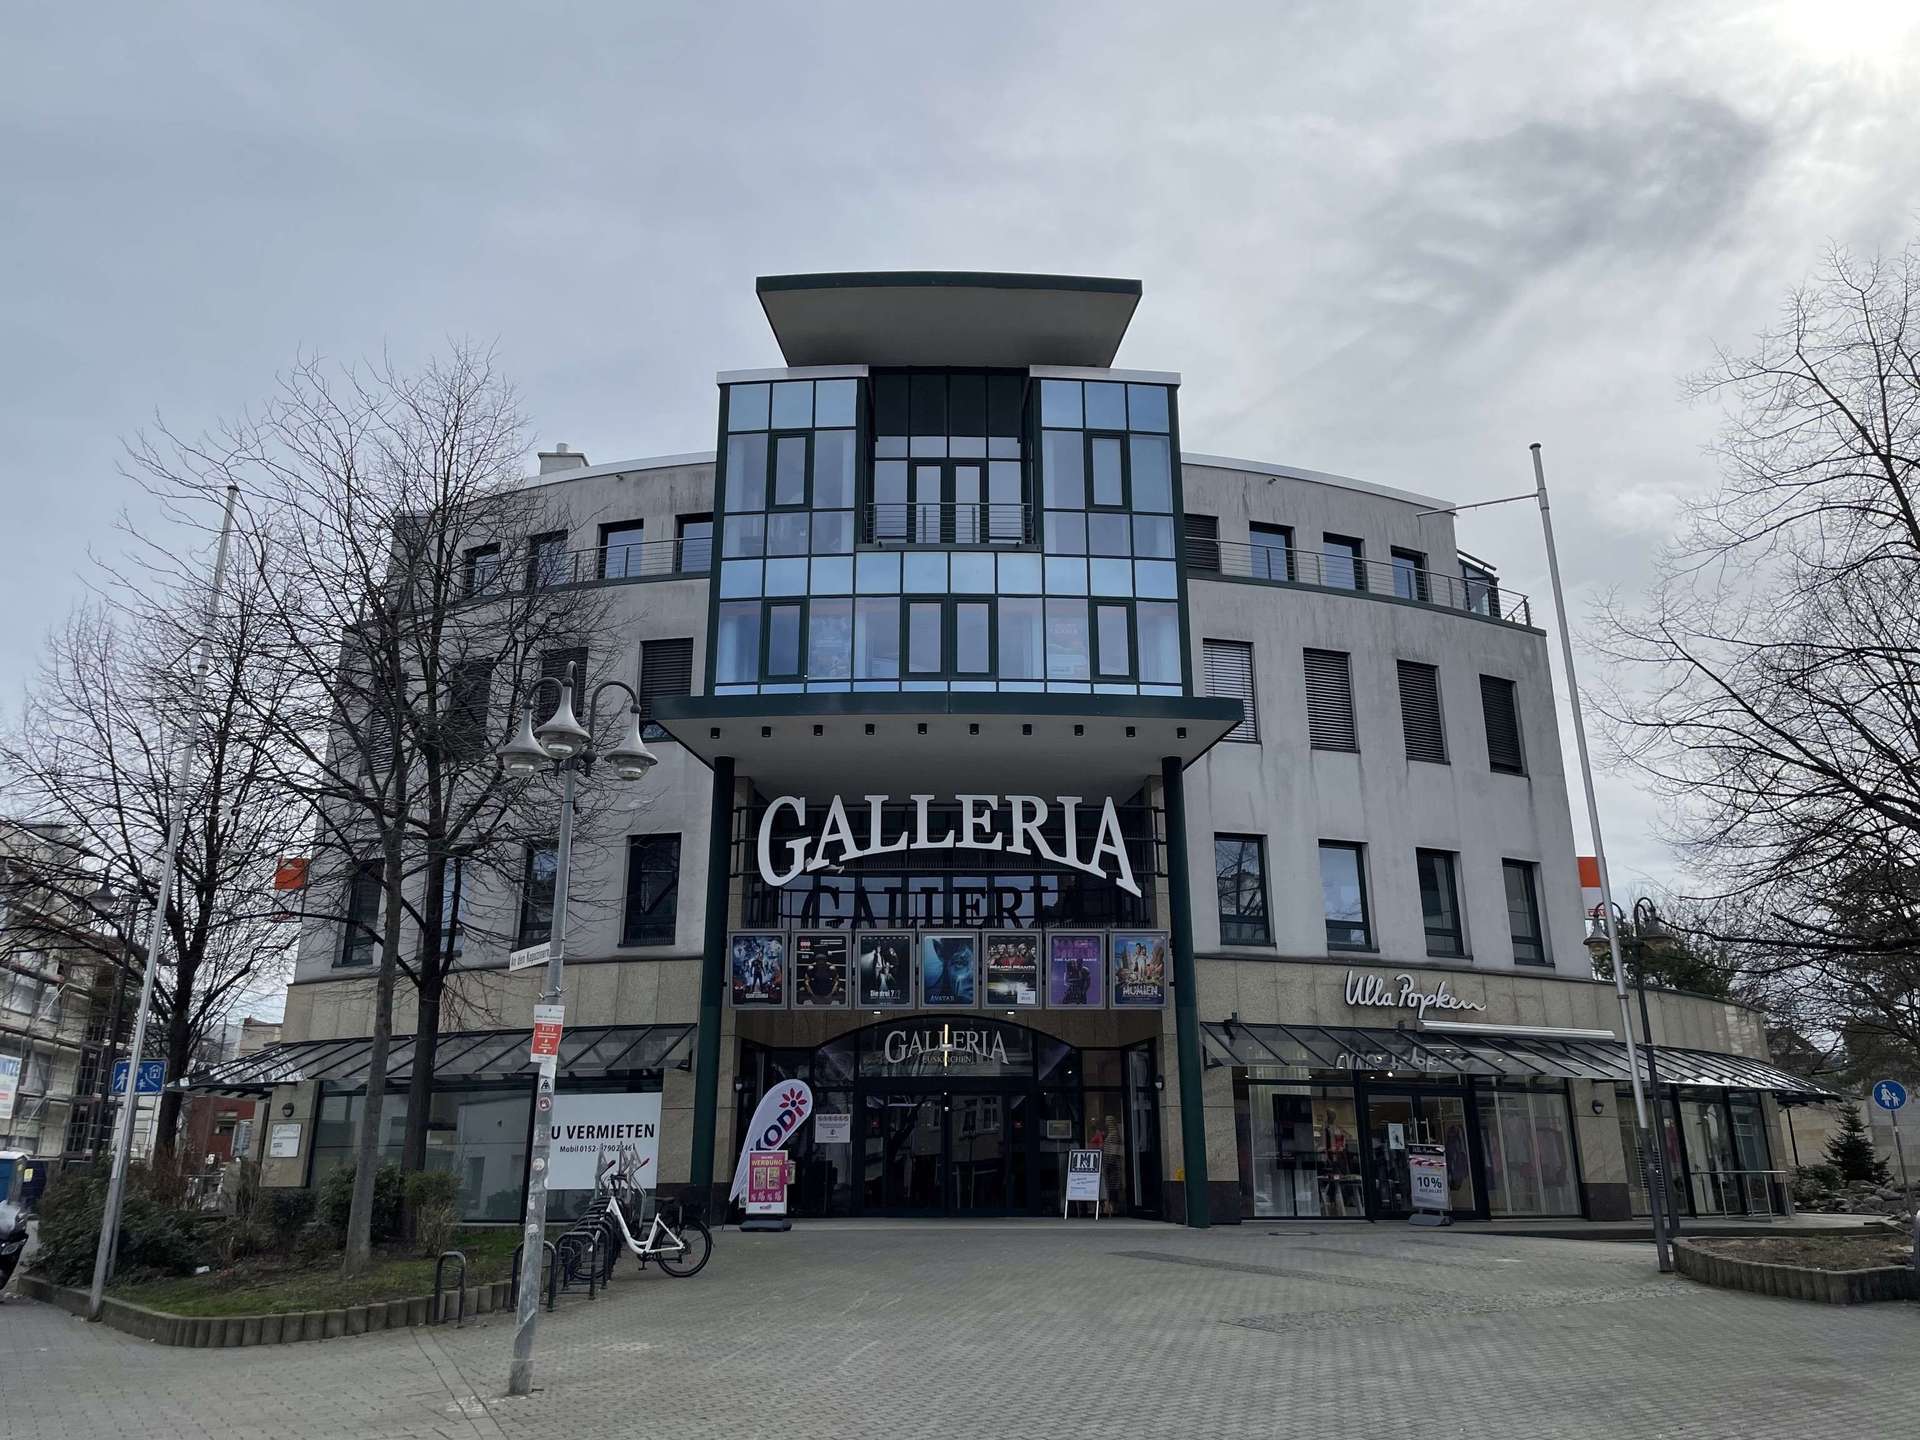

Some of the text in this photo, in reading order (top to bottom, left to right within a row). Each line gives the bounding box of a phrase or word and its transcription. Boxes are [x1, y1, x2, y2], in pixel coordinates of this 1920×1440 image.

[758, 794, 1142, 898] GALLERIA
[1345, 970, 1487, 1019] Ulla Popken
[884, 1030, 1010, 1065] GALLERIA
[551, 1124, 655, 1140] U VERMIETEN
[559, 1144, 579, 1153] Mobil
[1417, 1176, 1442, 1189] 10%
